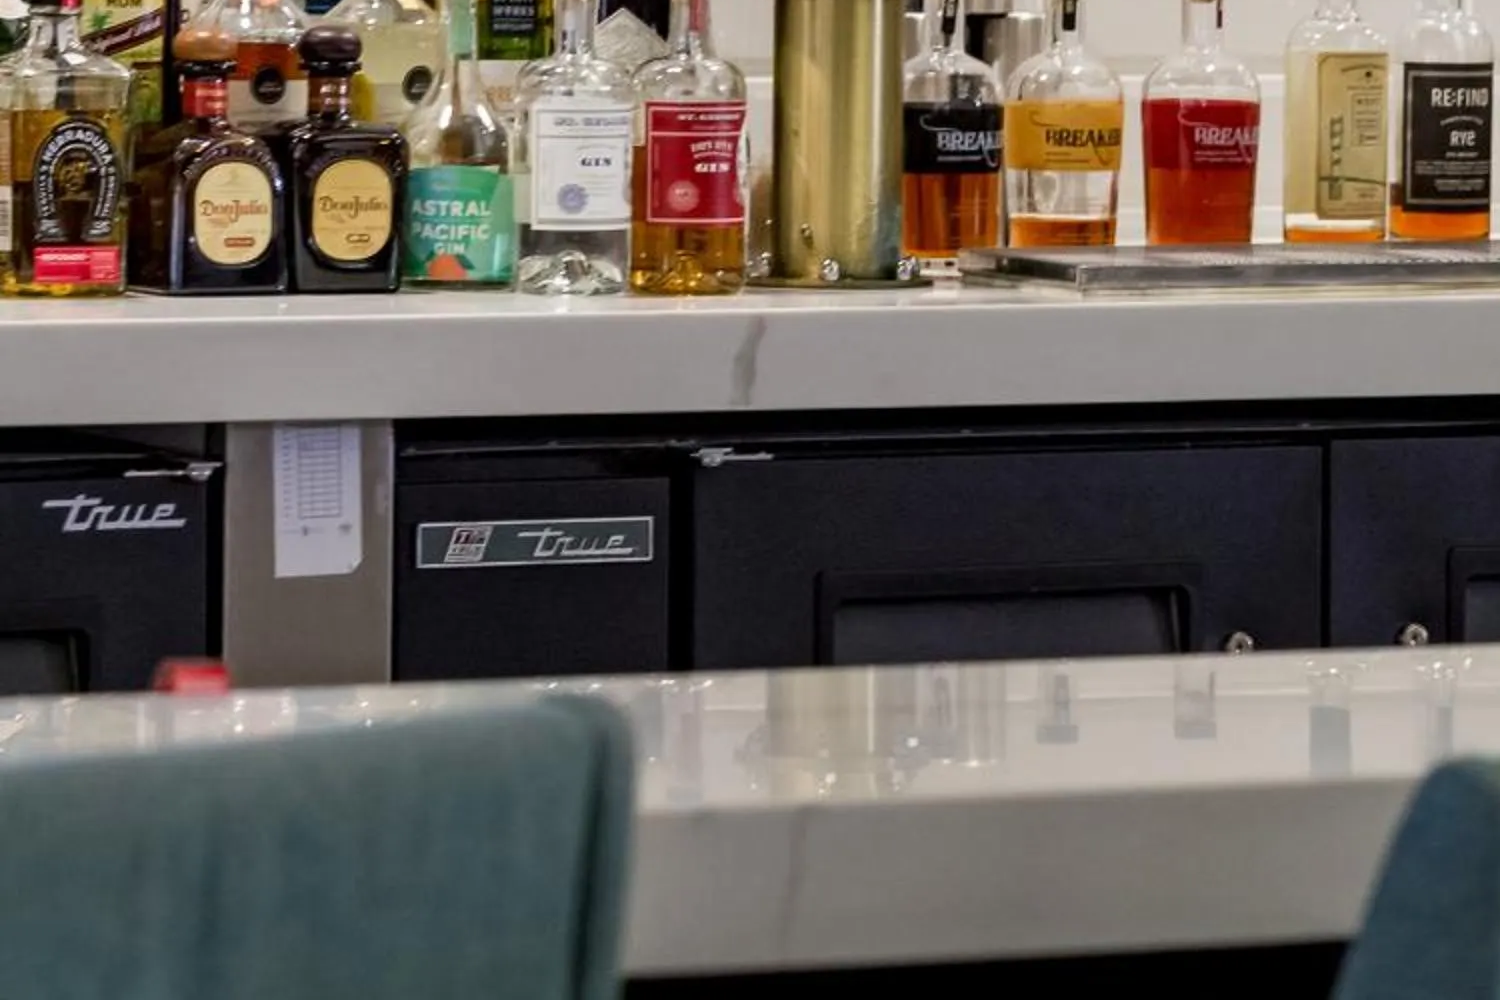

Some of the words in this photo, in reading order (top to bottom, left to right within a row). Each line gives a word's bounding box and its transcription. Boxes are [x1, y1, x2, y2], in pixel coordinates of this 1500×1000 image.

[1430, 87, 1489, 108] RE:FIND
[580, 157, 612, 167] GIN
[413, 199, 492, 217] ASTRAL
[412, 221, 491, 240] PACIFIC
[433, 242, 465, 255] GIN
